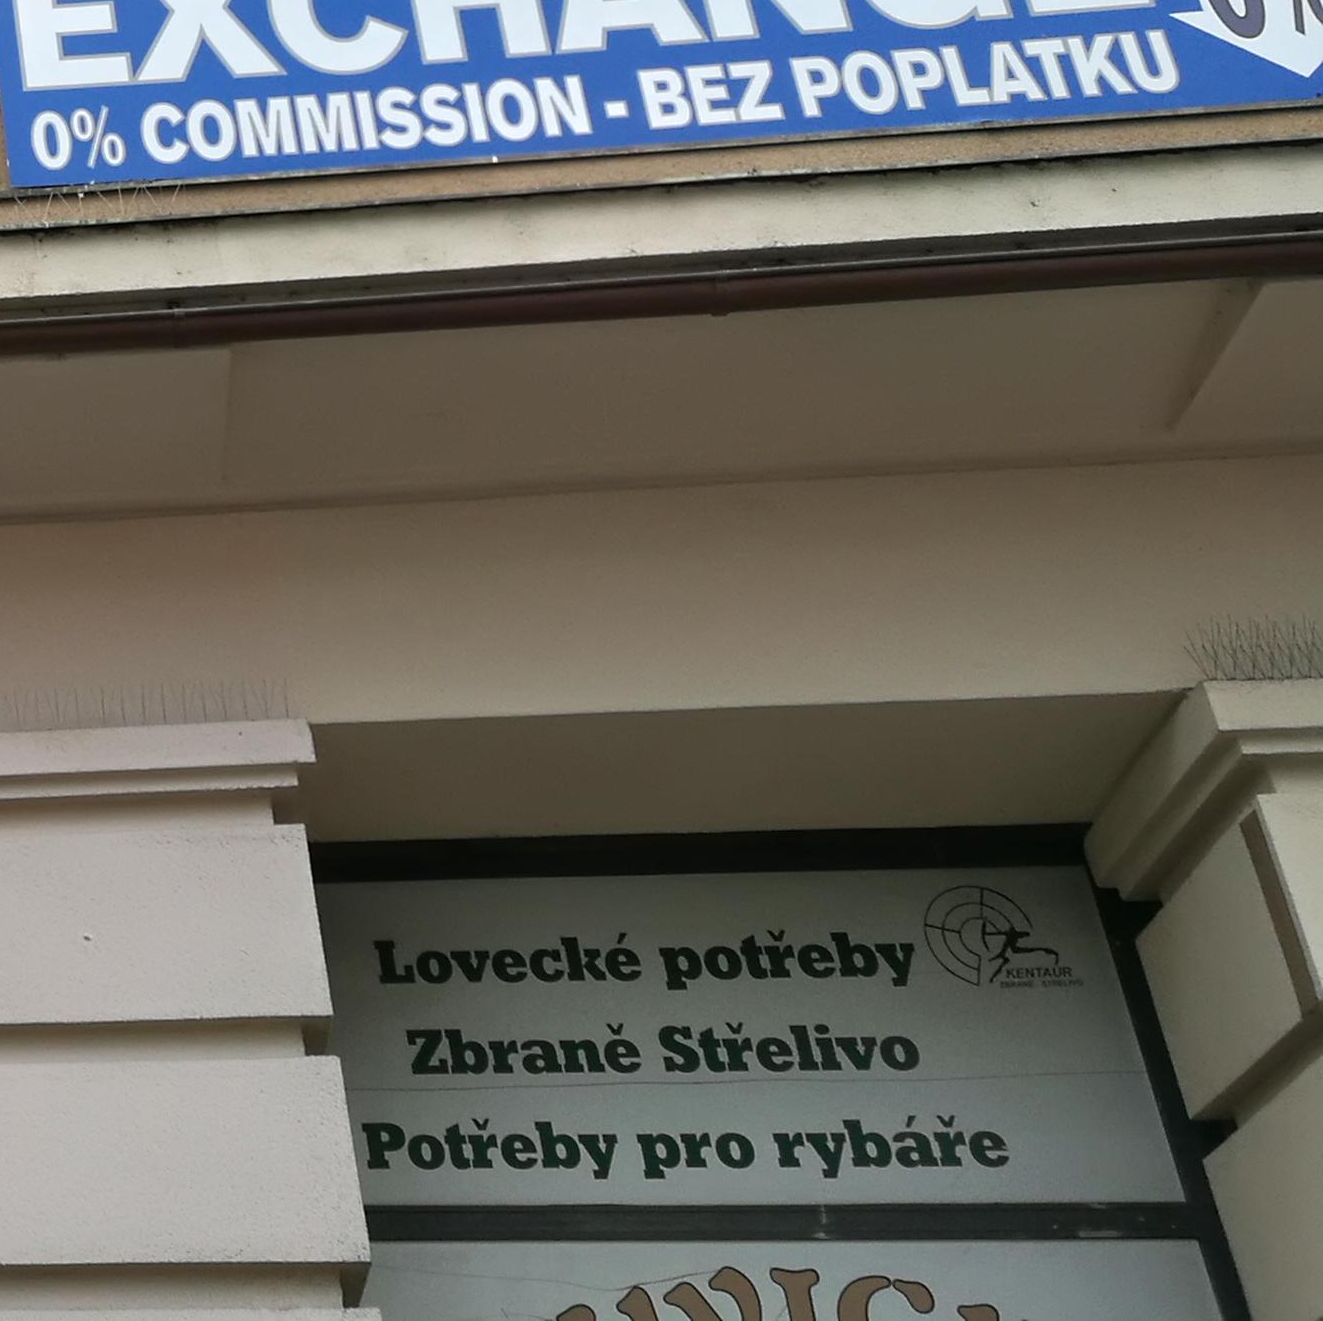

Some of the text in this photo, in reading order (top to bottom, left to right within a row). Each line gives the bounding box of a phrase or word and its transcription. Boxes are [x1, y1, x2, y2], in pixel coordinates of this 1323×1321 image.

[30, 28, 1180, 171] 0% COMMISSION - BEZ POPLATKU
[373, 930, 915, 990] Lovecké potřeby
[1006, 967, 1072, 979] KENTAUR
[406, 1022, 920, 1075] Zbraně Střelivo
[361, 1115, 1010, 1179] Potřeby pro rybáře
